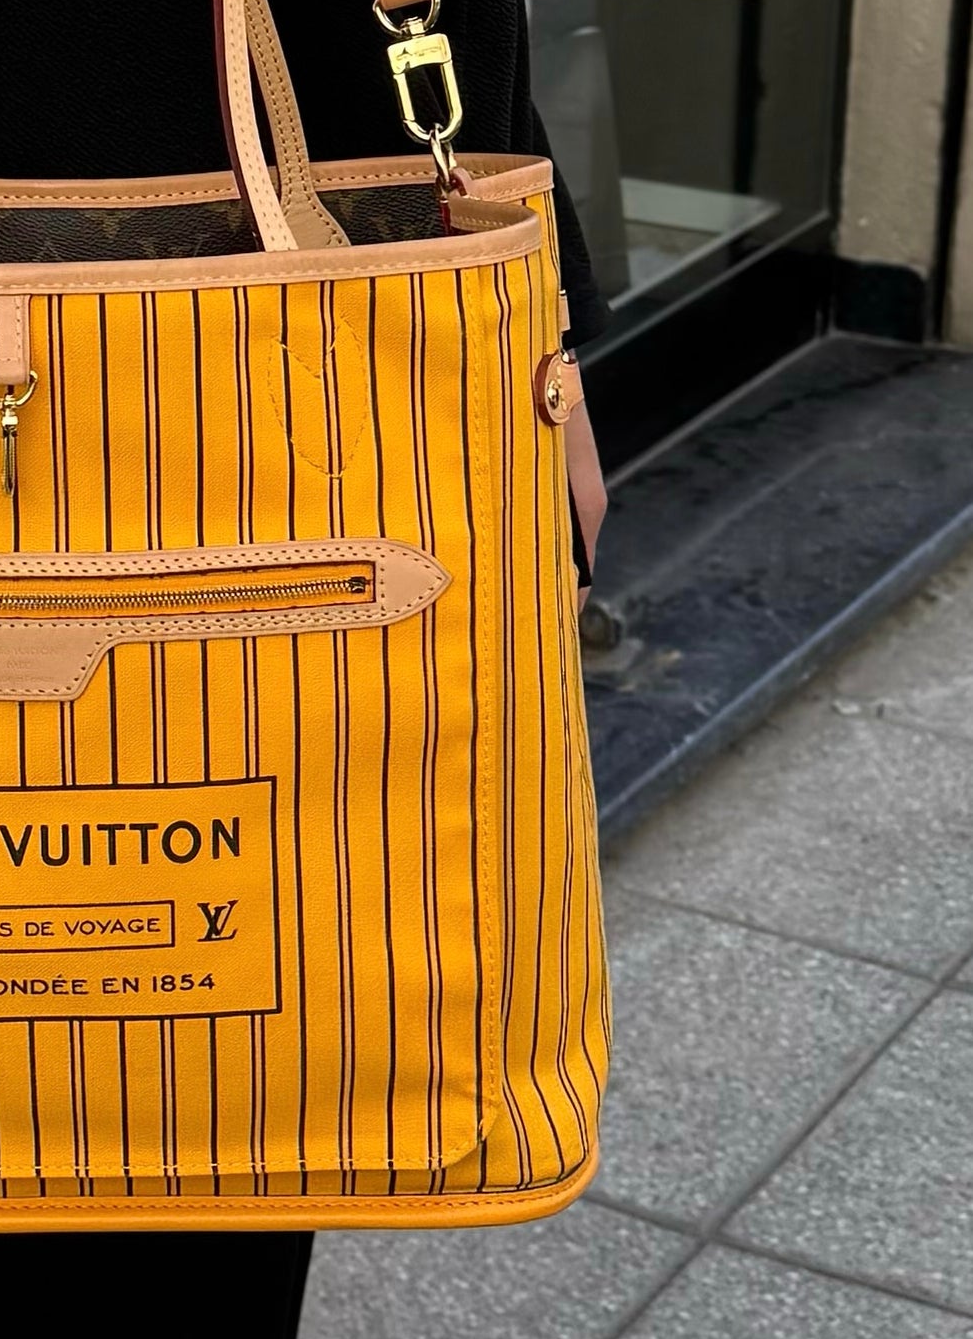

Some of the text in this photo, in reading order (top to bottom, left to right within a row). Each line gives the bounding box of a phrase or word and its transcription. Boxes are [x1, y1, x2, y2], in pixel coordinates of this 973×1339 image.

[0, 816, 240, 867] VUITTON
[25, 921, 55, 937] DE
[64, 918, 161, 936] VOYAGE
[101, 977, 139, 994] EN
[152, 973, 215, 993] 1854
